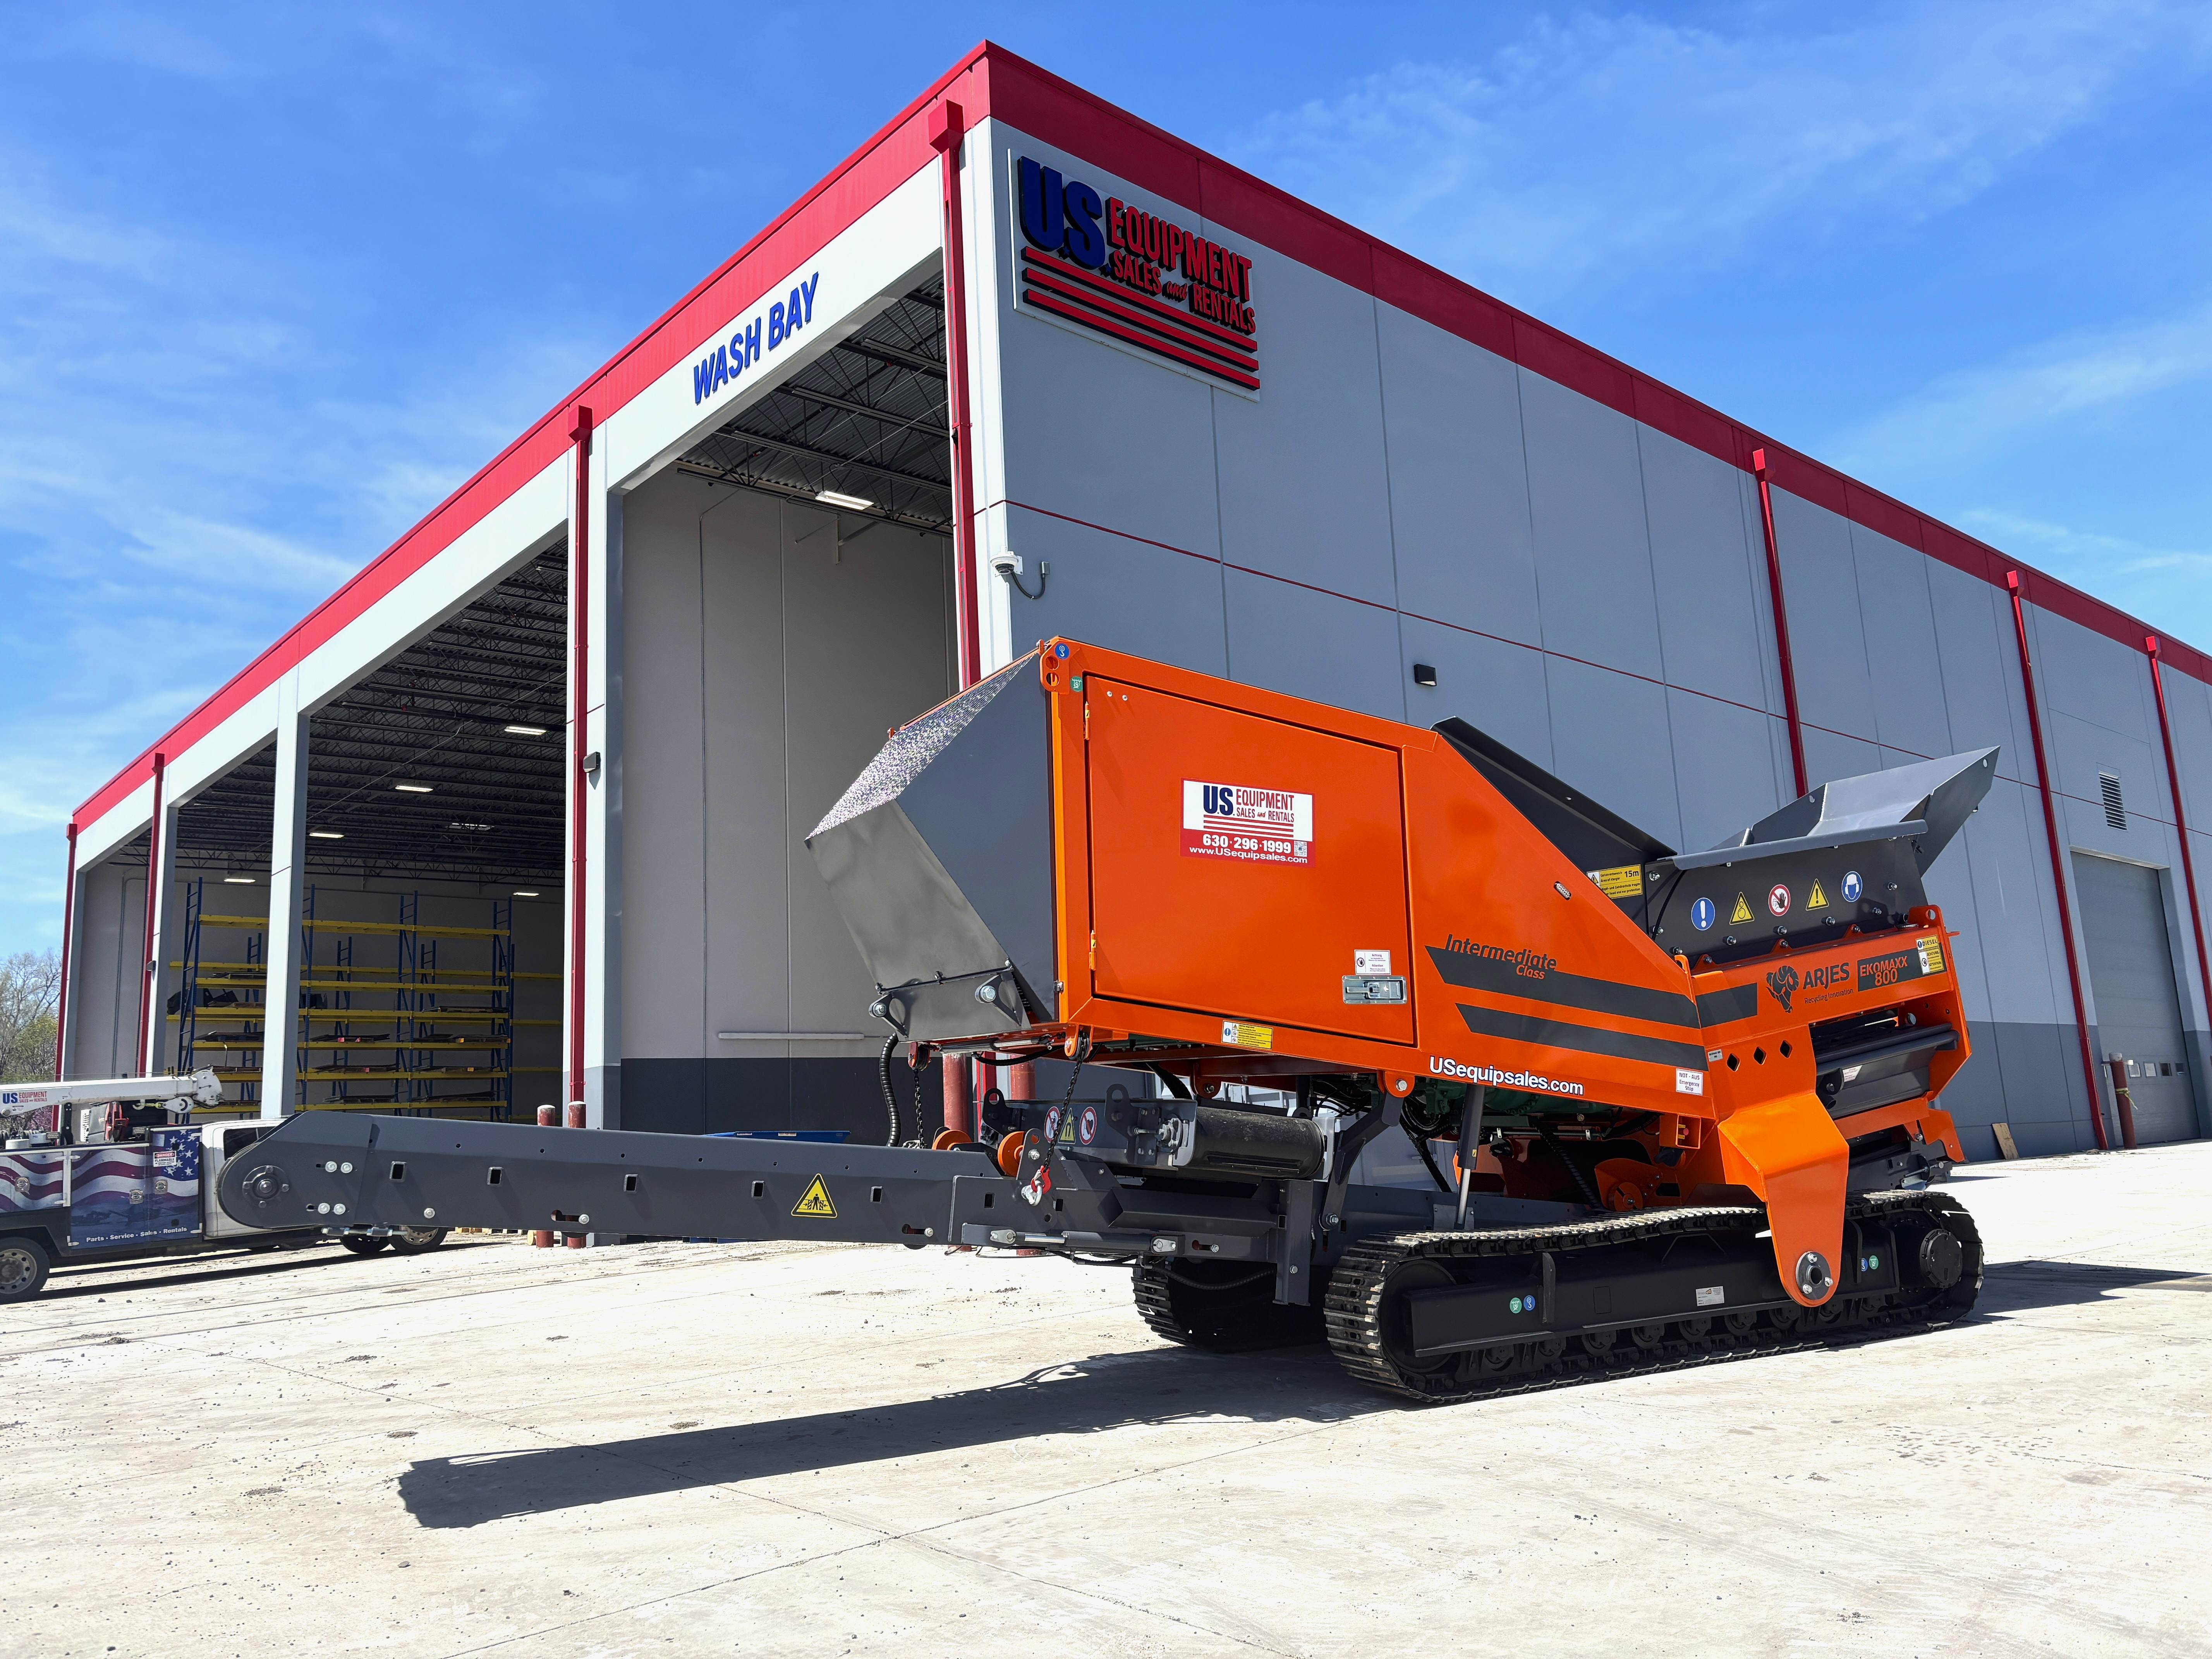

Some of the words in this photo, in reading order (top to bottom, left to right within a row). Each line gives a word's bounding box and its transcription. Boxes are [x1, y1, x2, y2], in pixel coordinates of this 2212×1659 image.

[1105, 197, 1252, 304] EQUIPMENT
[1109, 250, 1162, 296] SALES
[1162, 281, 1188, 302] and
[1189, 283, 1256, 335] RENTALS
[694, 316, 761, 405] WASH
[768, 271, 819, 352] BAY
[1236, 788, 1294, 811] EQUIPMENT
[1237, 807, 1255, 818] SALES
[1268, 810, 1294, 823] RENTALS
[1189, 846, 1307, 864] www.USequipsales.com
[1445, 934, 1557, 969] Intermediate
[1516, 965, 1545, 979] Class
[1803, 962, 1850, 989] ARJES
[1860, 956, 1908, 977] EKOMAXX
[1875, 968, 1898, 986] 800
[1828, 989, 1853, 998] Innovation
[1429, 1056, 1583, 1095] USequipsales.com
